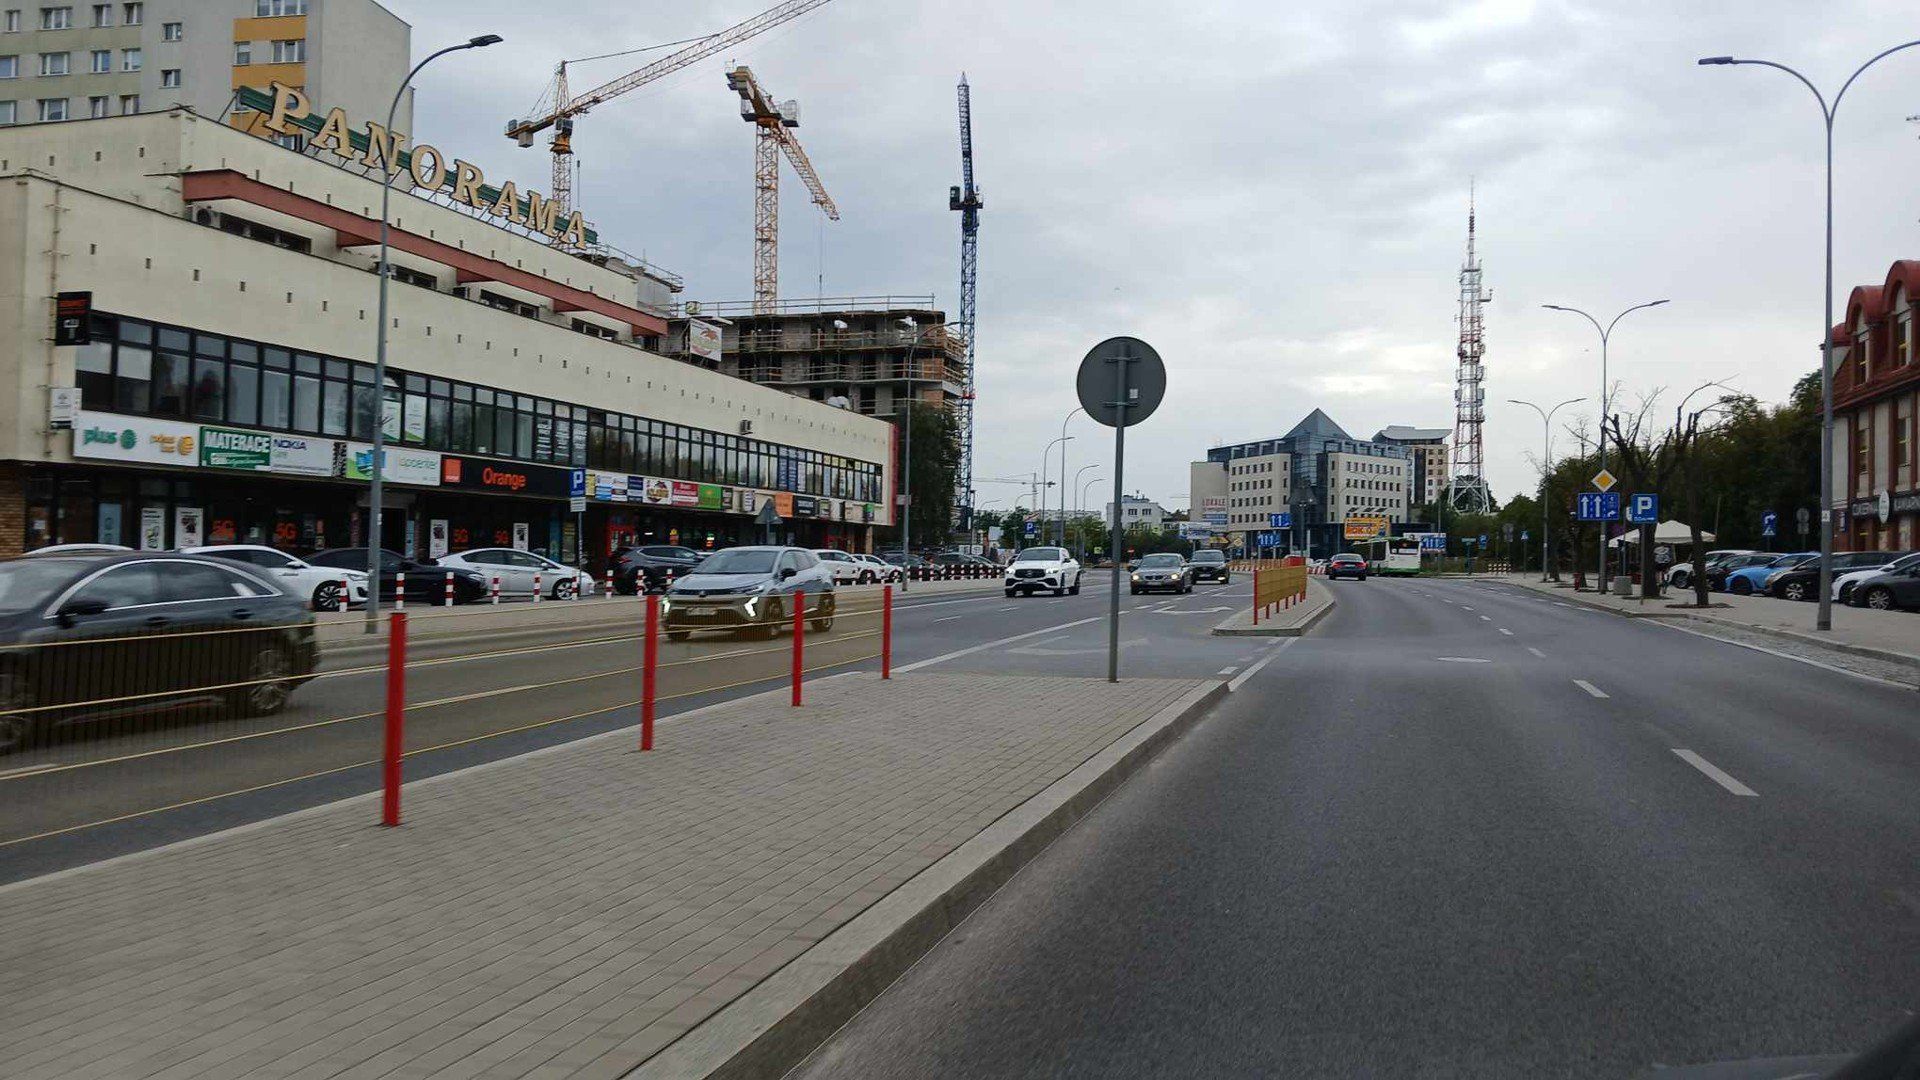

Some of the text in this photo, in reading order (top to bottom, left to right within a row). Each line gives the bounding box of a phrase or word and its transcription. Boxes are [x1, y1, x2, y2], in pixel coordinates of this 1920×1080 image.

[264, 81, 588, 250] PANORAMA
[83, 426, 117, 445] plus
[204, 430, 271, 453] MATERACE
[274, 438, 307, 450] NOKIA
[483, 466, 526, 490] Orange
[573, 471, 584, 489] P
[1637, 496, 1652, 515] P
[1026, 522, 1034, 531] P
